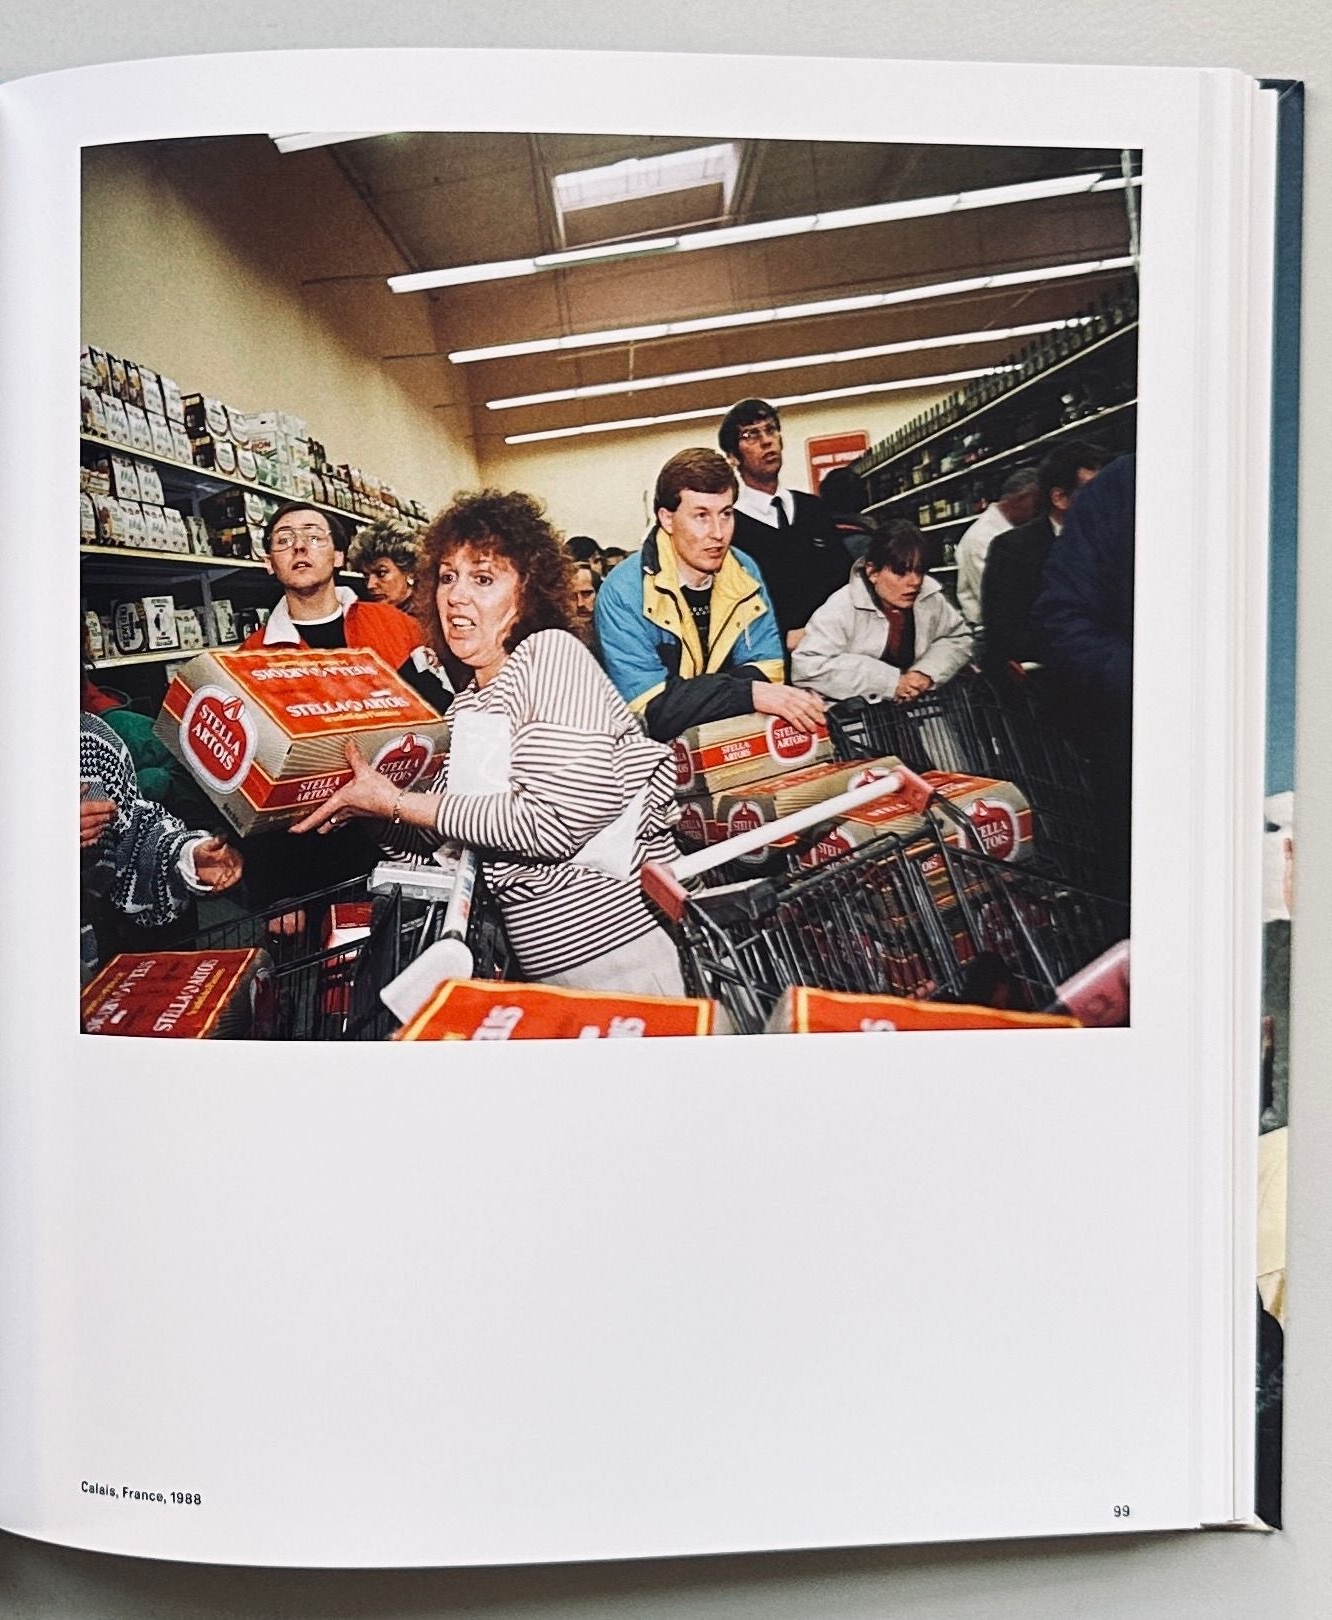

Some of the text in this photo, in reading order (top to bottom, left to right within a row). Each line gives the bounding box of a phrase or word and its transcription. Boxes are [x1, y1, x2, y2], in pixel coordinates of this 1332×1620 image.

[285, 700, 348, 718] STELLA
[199, 704, 240, 756] STELLA
[191, 722, 235, 771] ARTOIS
[721, 741, 751, 754] STELLA
[777, 734, 809, 749] ARTOIS
[724, 749, 752, 763] ARTOIS
[379, 758, 419, 774] STELLA
[299, 776, 341, 793] STELLA
[297, 786, 336, 802] ARTOIS
[977, 820, 1009, 838] ELLA
[983, 834, 1011, 850] TOIS
[921, 858, 939, 872] OIS
[81, 1481, 202, 1506] Calais, France, 1988
[1113, 1505, 1130, 1517] 99
